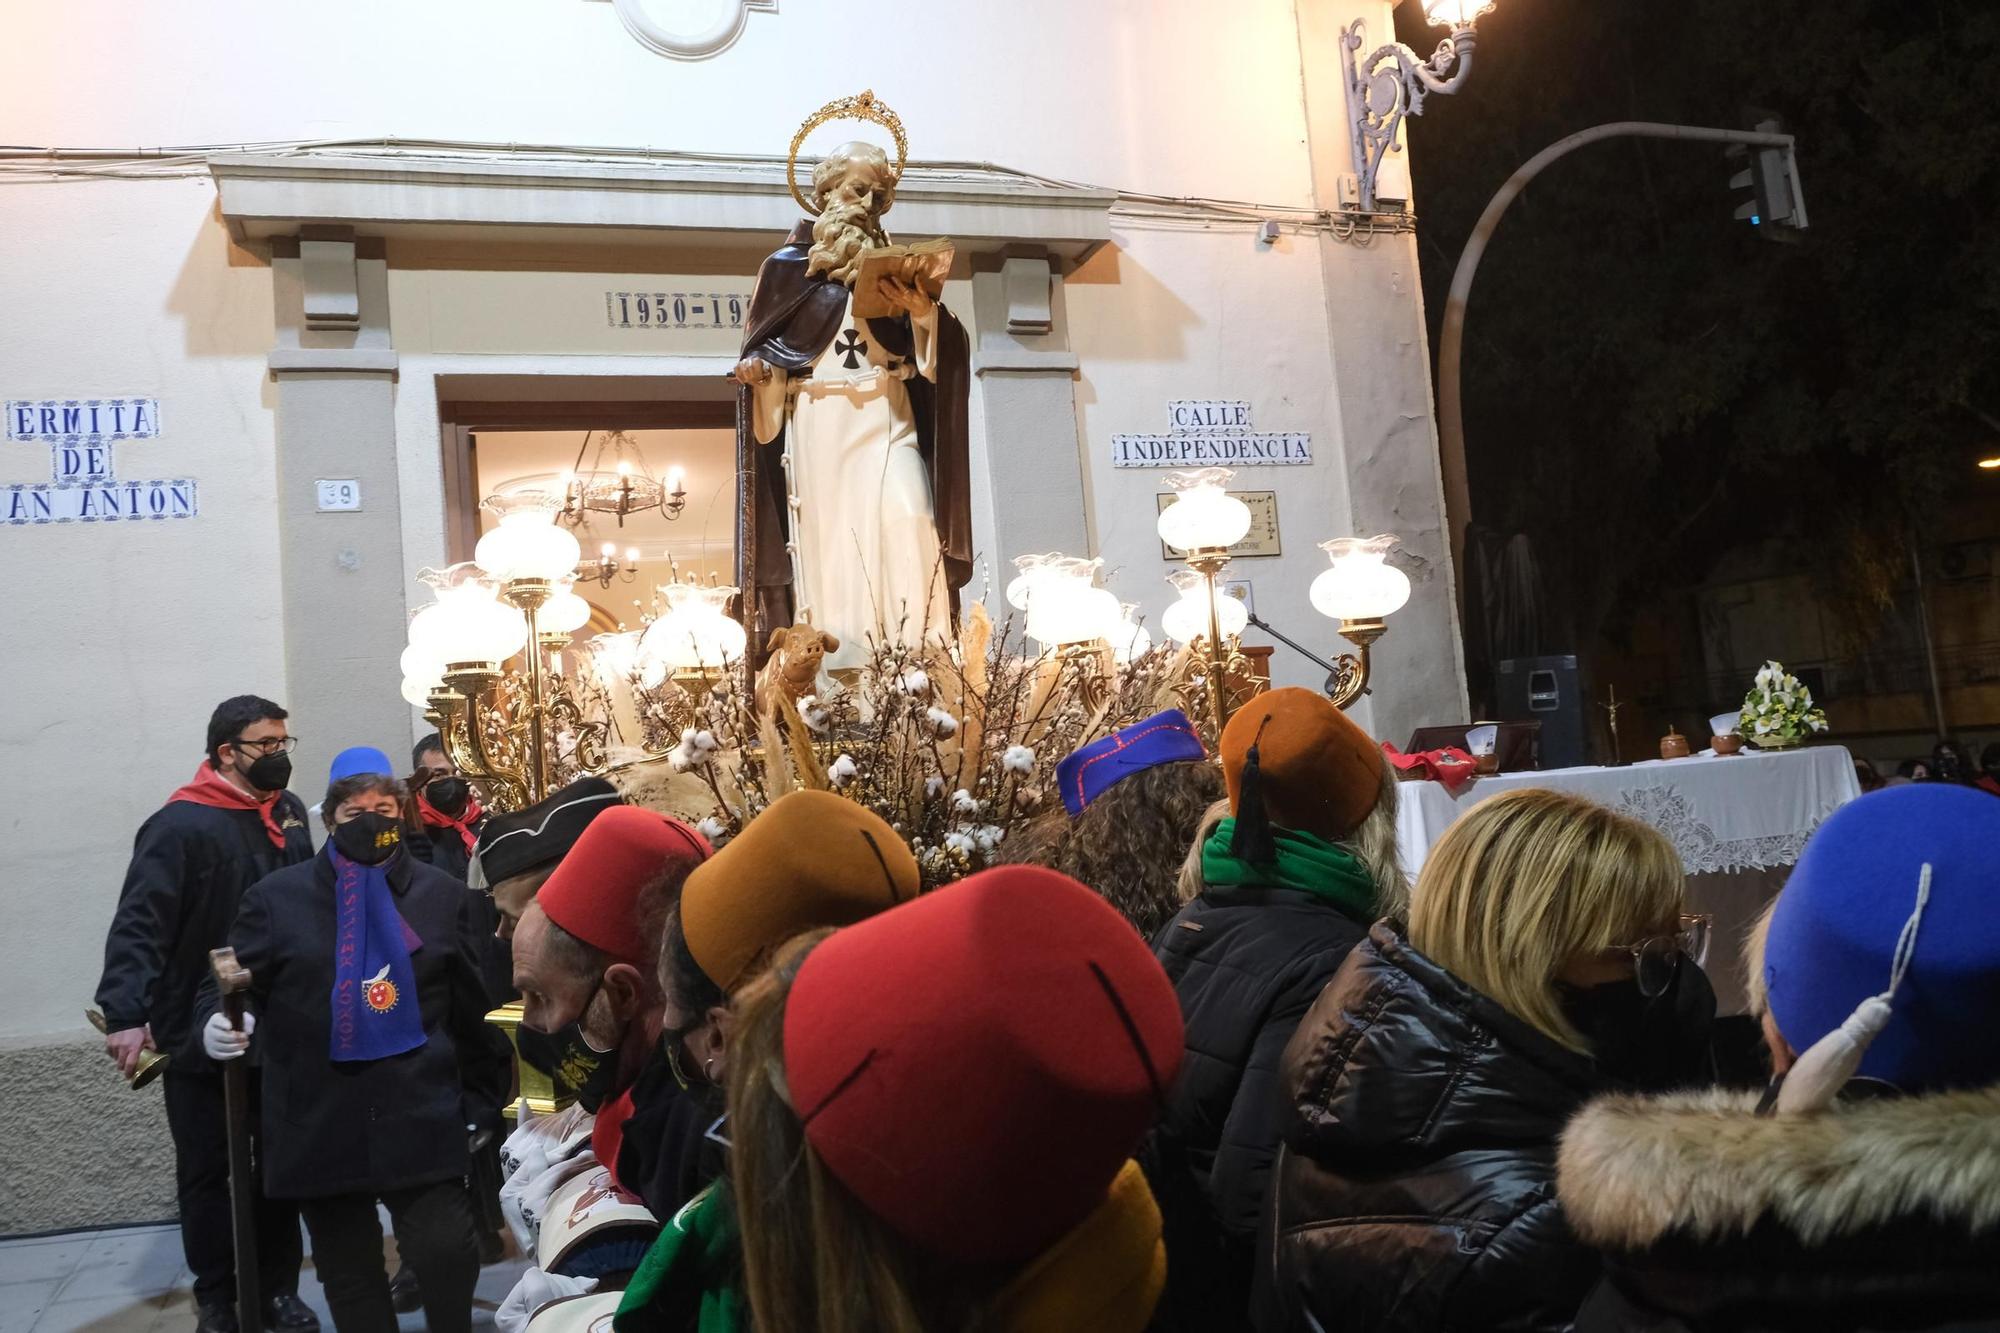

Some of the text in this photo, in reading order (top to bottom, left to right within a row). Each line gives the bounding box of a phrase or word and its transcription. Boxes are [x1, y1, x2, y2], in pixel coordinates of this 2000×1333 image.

[619, 297, 752, 324] 1950-19
[15, 406, 152, 434] ERMITA
[1174, 406, 1248, 426] CALLE
[62, 448, 105, 475] DE
[1120, 438, 1308, 461] INDEPENDENCIA
[0, 486, 190, 519] AN ANTON
